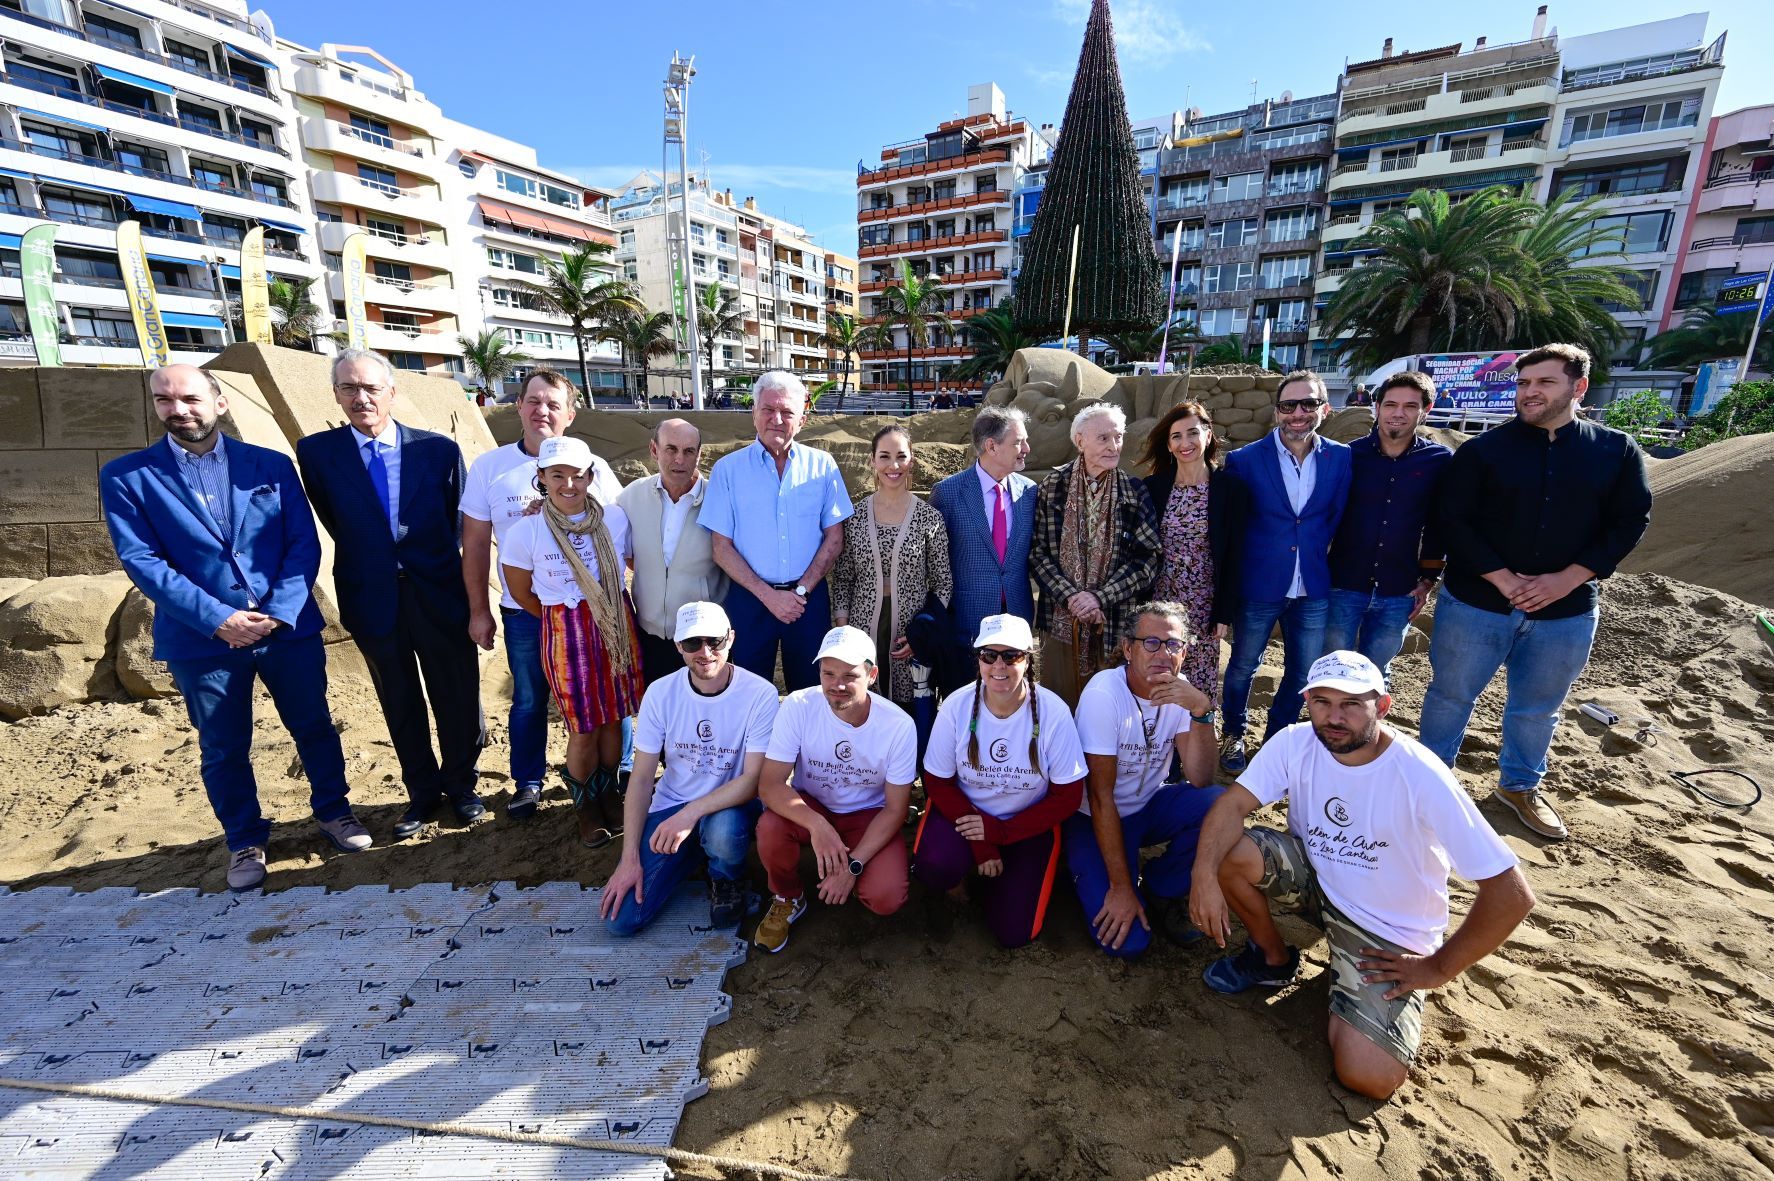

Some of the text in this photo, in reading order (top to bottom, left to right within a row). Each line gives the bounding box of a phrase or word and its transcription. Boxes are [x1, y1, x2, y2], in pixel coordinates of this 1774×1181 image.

[1725, 287, 1754, 300] 10:26
[1456, 391, 1488, 399] JULIO
[1333, 831, 1348, 843] de
[1308, 839, 1317, 847] de
[1320, 841, 1336, 853] Las
